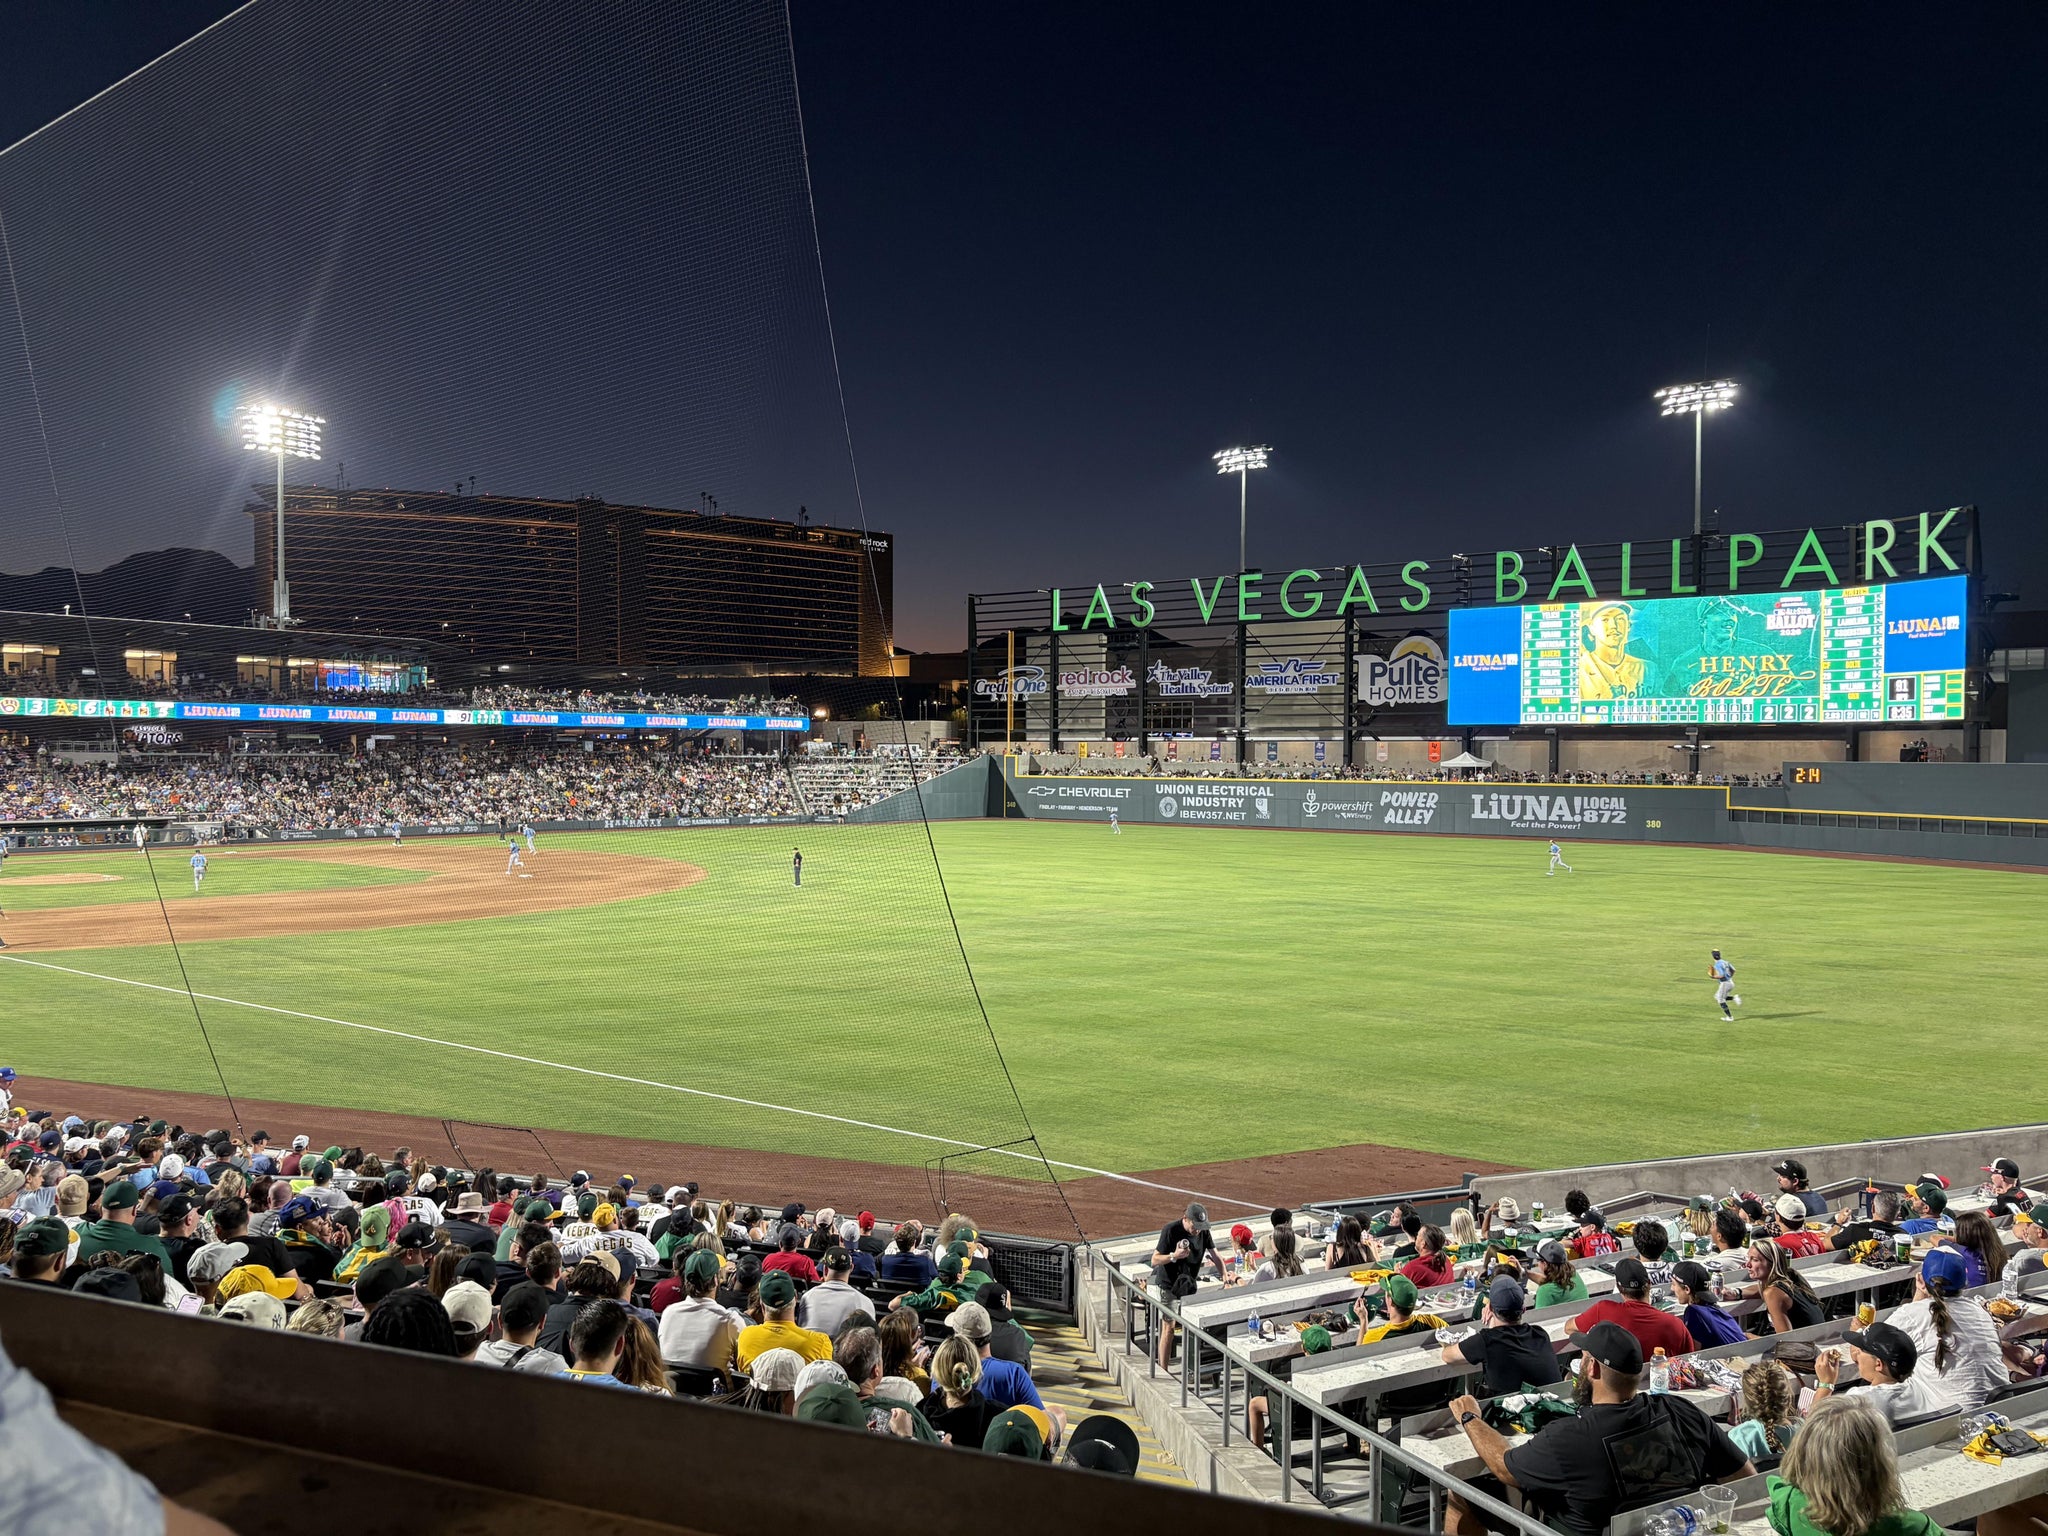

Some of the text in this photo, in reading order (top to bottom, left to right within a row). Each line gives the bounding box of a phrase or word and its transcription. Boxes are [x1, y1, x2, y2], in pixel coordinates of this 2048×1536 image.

[860, 538, 888, 548] red rock
[1052, 506, 1961, 631] LAS VEGAS BALLPARK
[1767, 615, 1815, 630] BALLOT
[1700, 655, 1793, 674] HENRY
[1059, 665, 1131, 685] red rock
[1160, 668, 1211, 684] The Valley
[1370, 658, 1440, 686] Pulte
[975, 678, 1013, 694] Credi
[1246, 673, 1338, 686] AMERICA FIRST
[1160, 682, 1230, 697] Health System
[1370, 686, 1438, 700] HOMES
[1764, 706, 1774, 720] 2
[1784, 706, 1794, 719] 2
[1804, 706, 1814, 720] 2
[1796, 767, 1820, 783] 2:14
[1059, 787, 1131, 798] CHEVROLET
[1155, 784, 1274, 796] UNION ELECTRICAL
[1182, 796, 1244, 808] INDUSTRY
[1321, 801, 1373, 812] powershift
[1380, 791, 1439, 809] POWER
[1583, 797, 1626, 810] LOCAL
[1471, 792, 1583, 823] LiUNA!
[1180, 810, 1246, 821] IBEW357.NET
[1384, 808, 1434, 825] ALLEY
[1583, 810, 1626, 824] 872
[1511, 821, 1529, 829] Feel
[1548, 822, 1581, 830] Power!
[1646, 820, 1661, 829] 380
[594, 1237, 633, 1251] VEGAS
